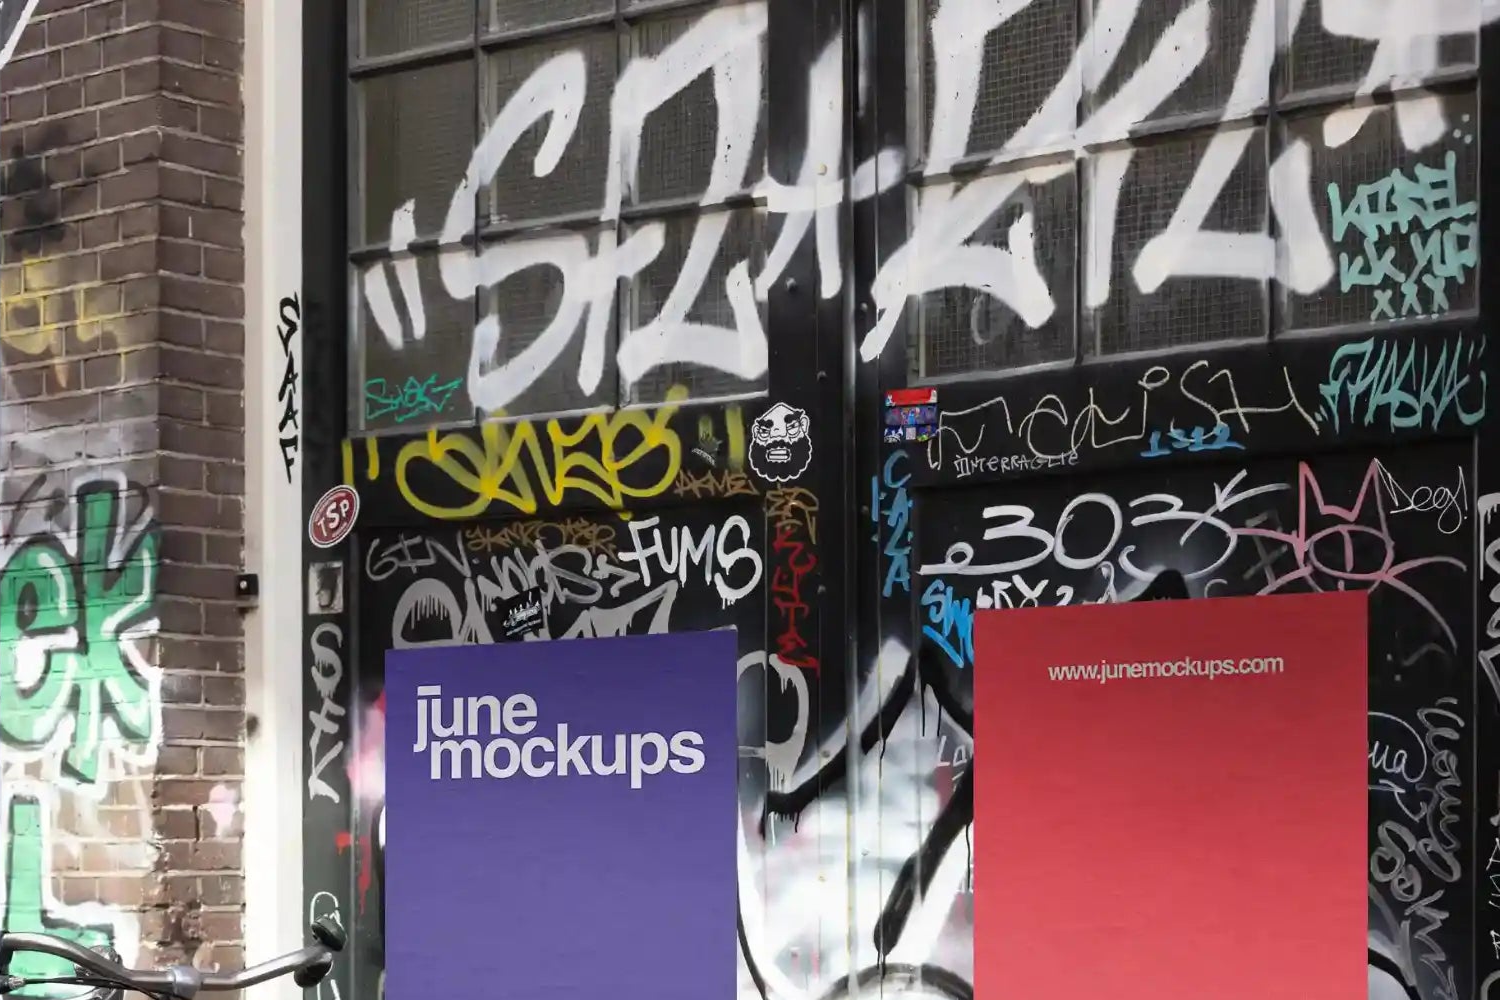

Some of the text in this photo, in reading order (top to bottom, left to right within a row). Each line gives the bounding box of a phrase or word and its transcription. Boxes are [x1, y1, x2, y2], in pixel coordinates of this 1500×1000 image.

[317, 499, 350, 537] TSP
[1048, 653, 1284, 683] www.junemockups.com
[414, 686, 536, 752] june
[431, 724, 704, 788] mockups
